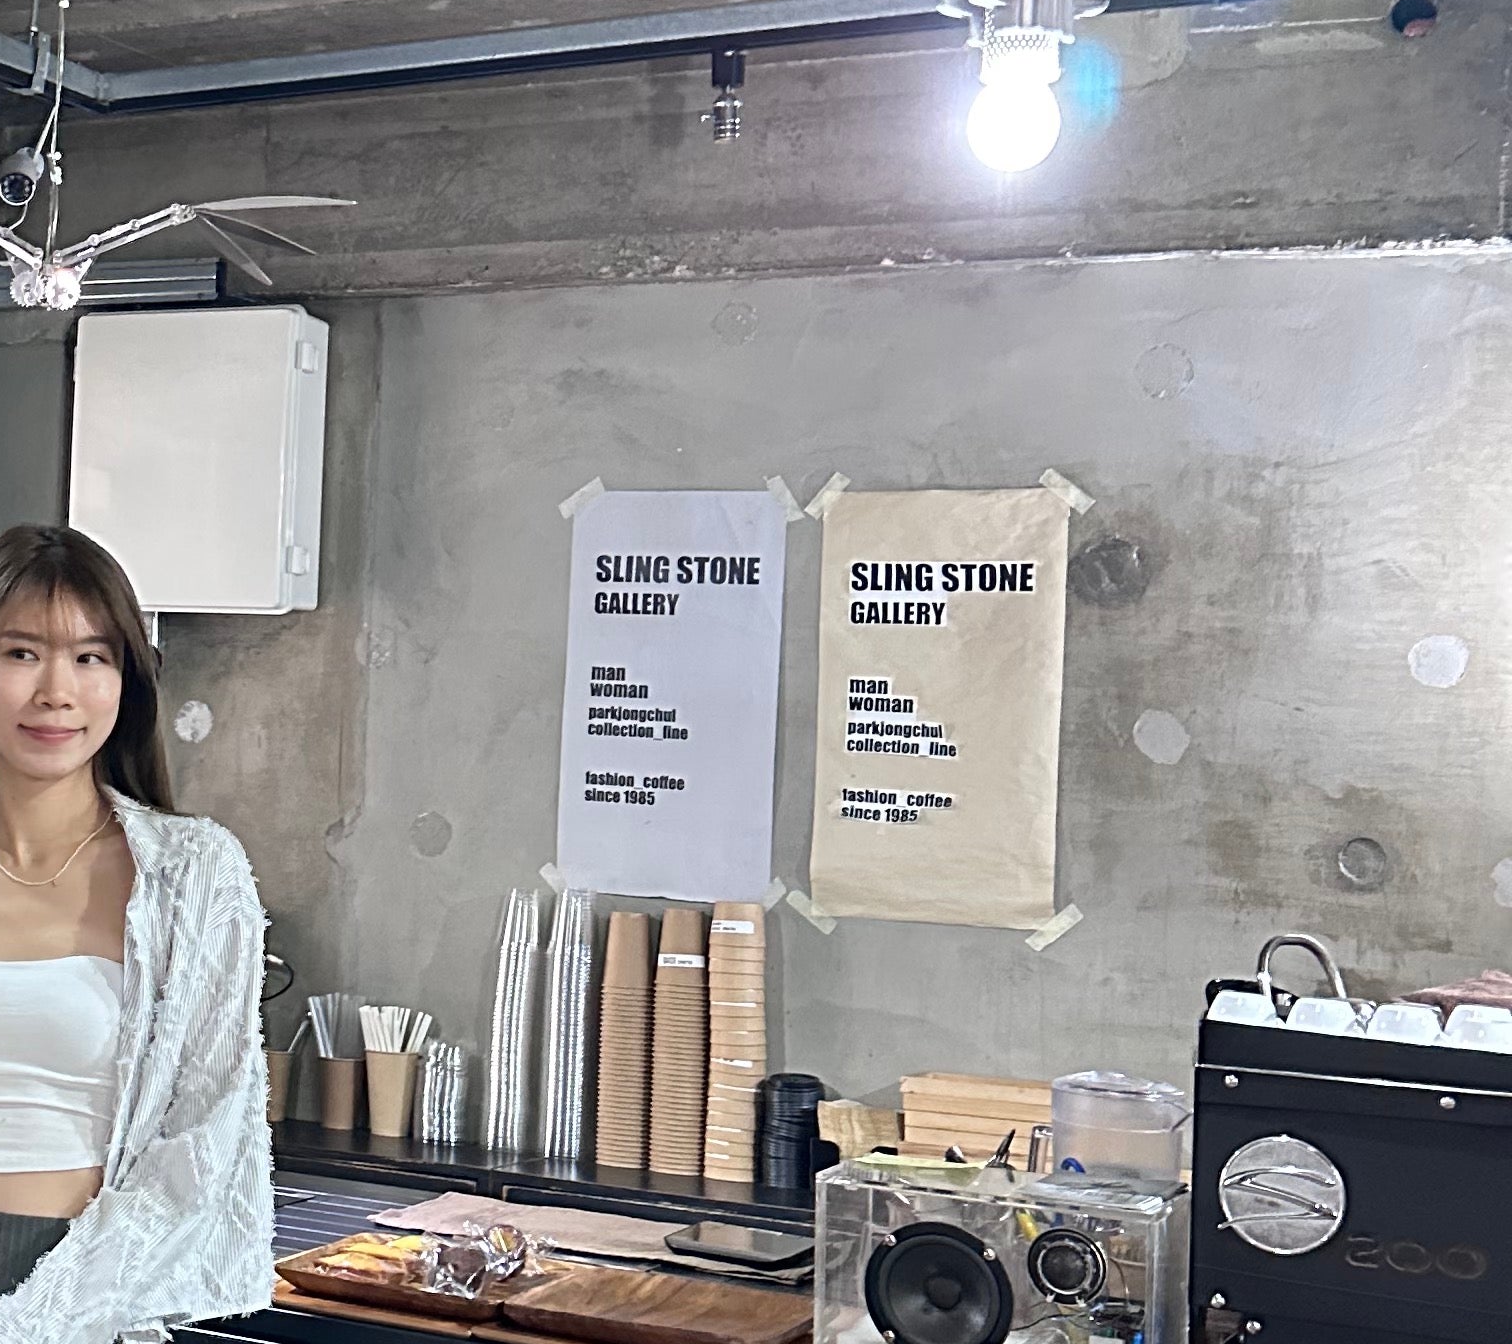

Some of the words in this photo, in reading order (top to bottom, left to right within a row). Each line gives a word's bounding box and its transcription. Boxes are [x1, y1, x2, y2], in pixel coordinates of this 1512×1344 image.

[596, 554, 670, 584] SLING
[676, 555, 761, 585] STONE
[851, 562, 934, 592] SLING
[941, 563, 1034, 592] STONE
[594, 591, 680, 616] GALLERY
[850, 601, 946, 626] GALLERY
[591, 666, 626, 681] man
[590, 682, 649, 699] woman
[849, 678, 889, 695] man
[848, 696, 914, 713] woman
[588, 706, 676, 723] parkjongchul
[847, 721, 943, 739] parkjongchul
[584, 787, 620, 803] since
[623, 790, 655, 806] 1985
[841, 805, 881, 821] since
[885, 808, 918, 823] 1985
[1345, 1236, 1487, 1281] 200
